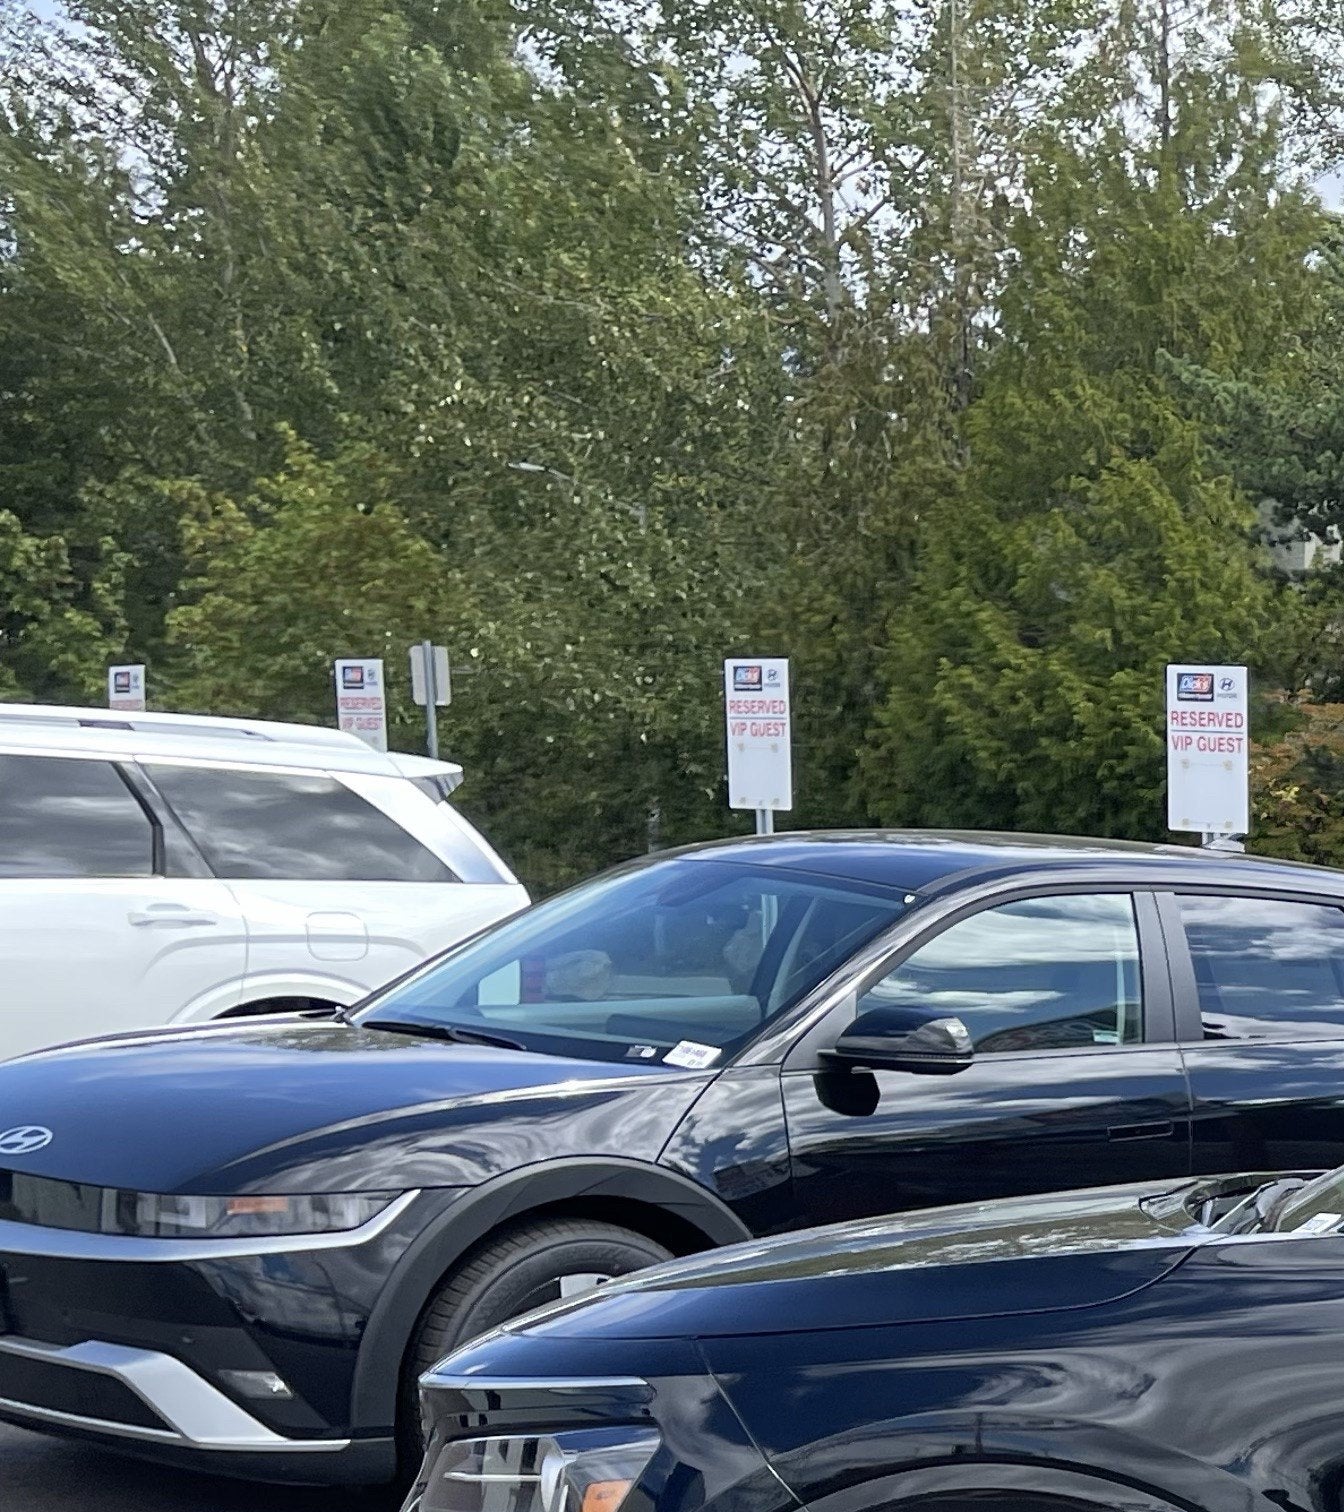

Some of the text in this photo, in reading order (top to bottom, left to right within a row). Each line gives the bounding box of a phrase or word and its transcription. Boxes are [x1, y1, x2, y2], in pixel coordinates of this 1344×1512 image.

[729, 700, 787, 714] RESERVED
[1170, 711, 1244, 728] RESERVED
[730, 722, 786, 737] VIP GUEST
[1171, 735, 1244, 753] VIP GUEST
